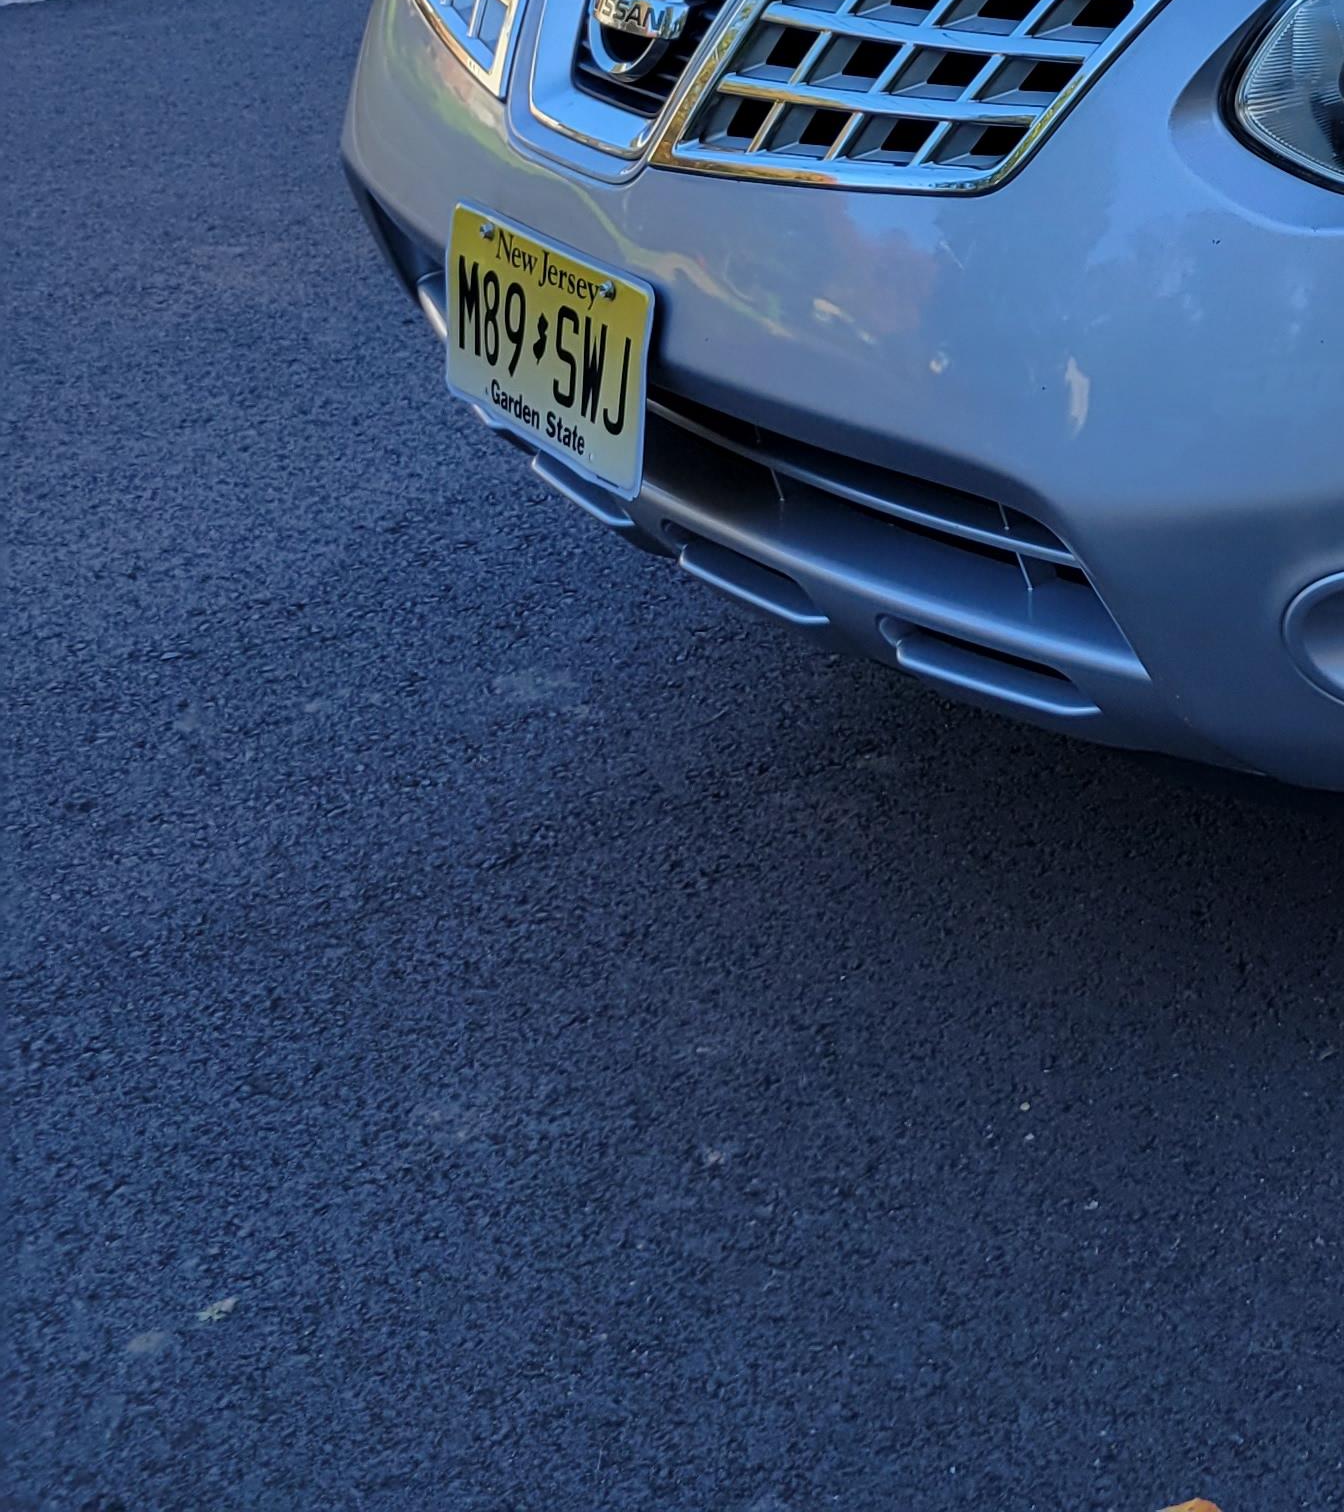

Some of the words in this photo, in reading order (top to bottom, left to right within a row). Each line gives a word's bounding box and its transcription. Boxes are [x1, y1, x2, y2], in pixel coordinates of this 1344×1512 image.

[495, 231, 538, 274] New
[538, 250, 601, 310] Jersey
[458, 255, 526, 377] M89
[552, 305, 632, 436] SWJ
[491, 379, 540, 430] Garden
[545, 411, 586, 454] State
